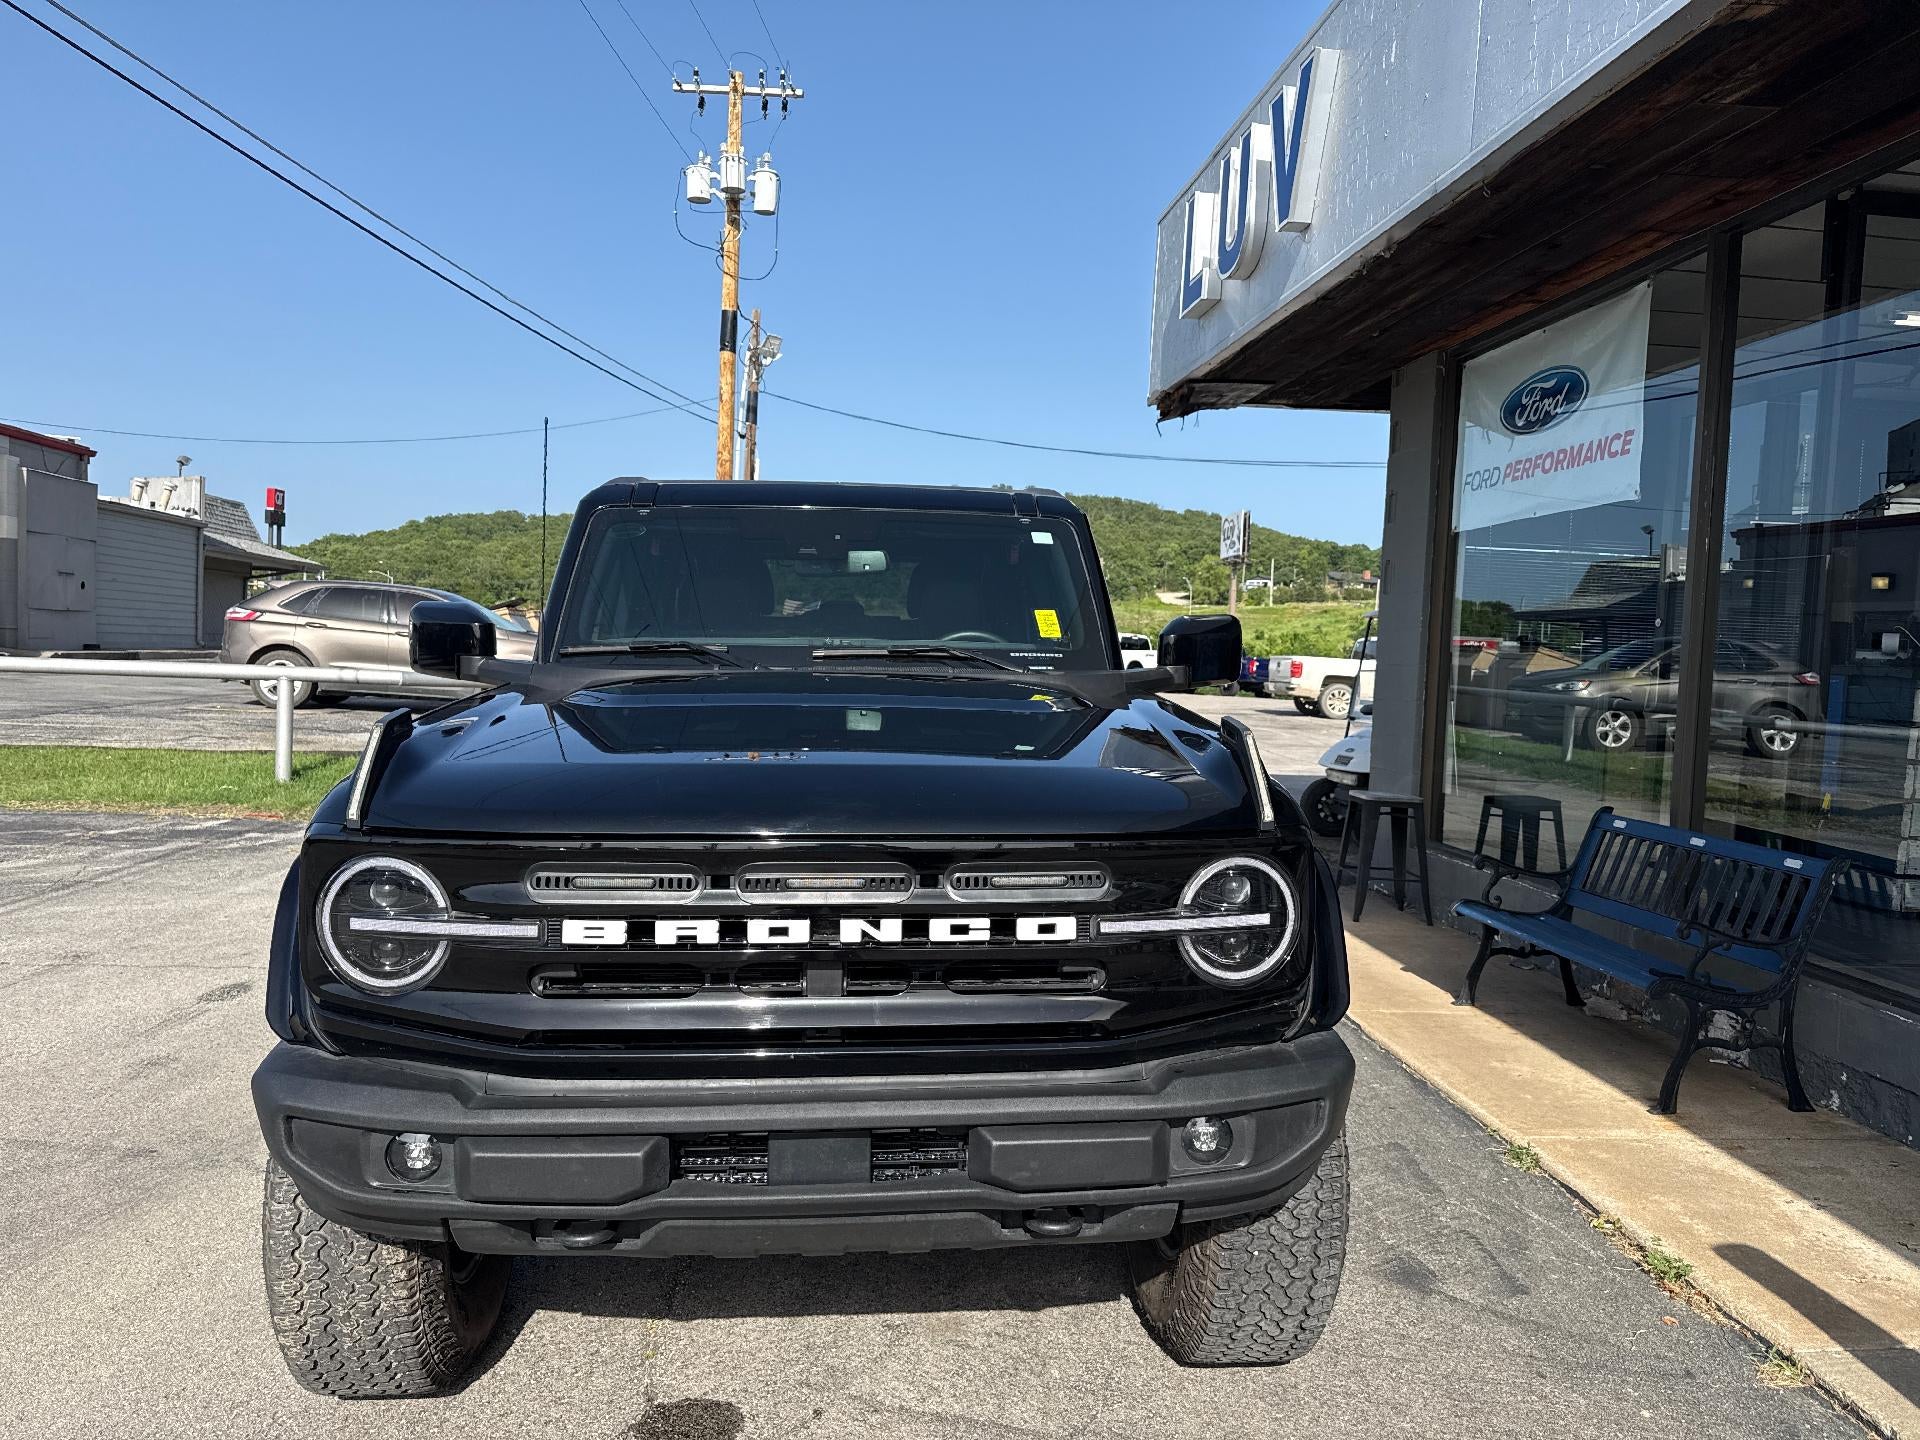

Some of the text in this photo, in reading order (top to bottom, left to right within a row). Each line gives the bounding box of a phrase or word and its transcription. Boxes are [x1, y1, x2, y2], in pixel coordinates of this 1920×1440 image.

[1179, 47, 1335, 320] LUV
[1515, 377, 1571, 427] Ford
[1463, 428, 1636, 493] FORD PERFORMANCE
[561, 916, 1077, 945] BRONCO
